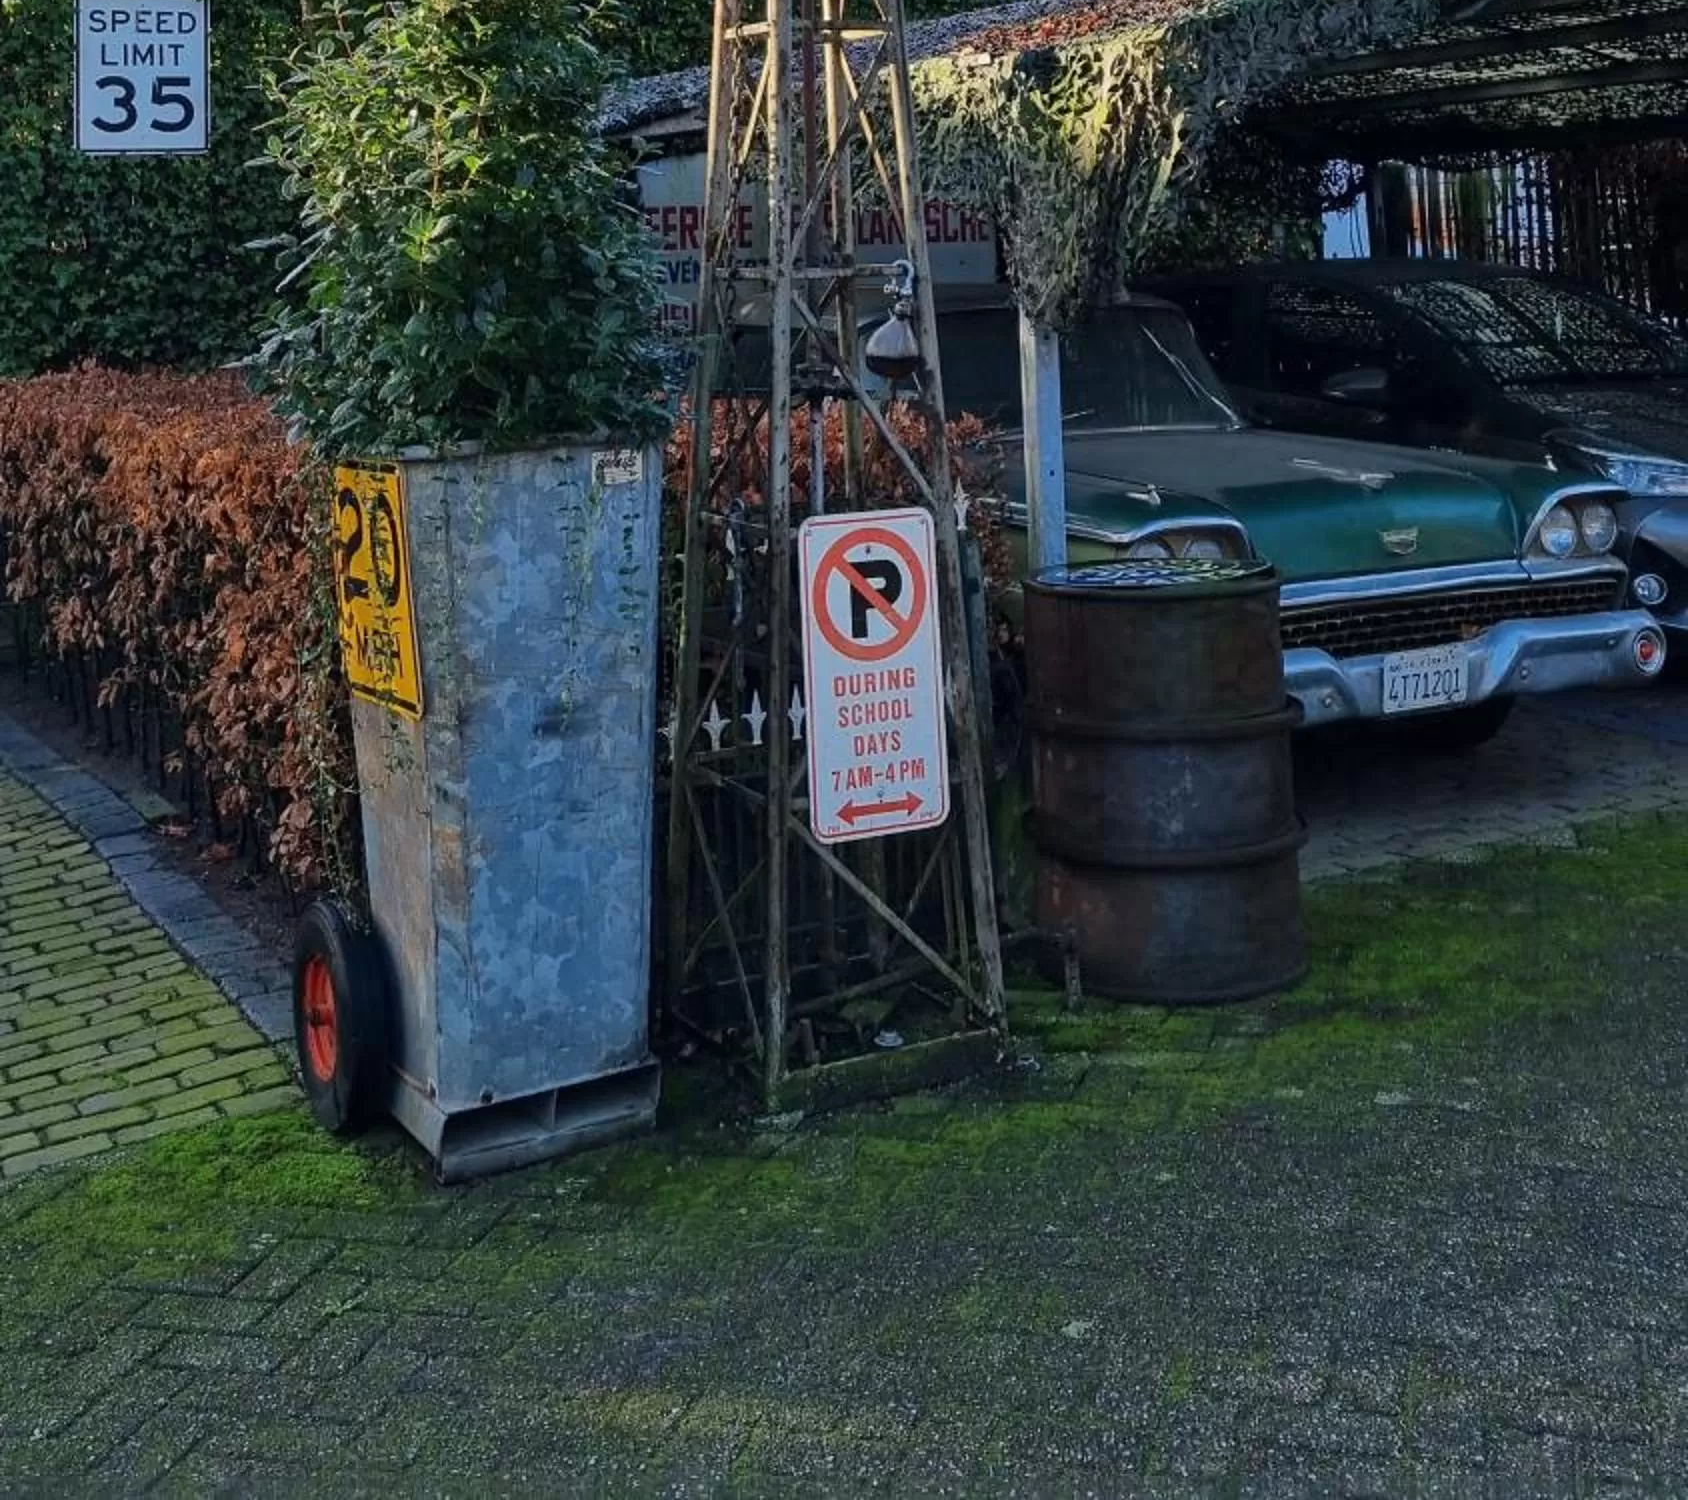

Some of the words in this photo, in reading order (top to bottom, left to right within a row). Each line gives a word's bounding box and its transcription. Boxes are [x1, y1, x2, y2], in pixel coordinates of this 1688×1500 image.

[89, 9, 197, 34] SPEED
[101, 43, 184, 67] LIMIT
[91, 76, 195, 133] 35
[338, 487, 400, 607] 20
[834, 667, 915, 697] DURING
[838, 699, 913, 729] SCHOOL
[854, 730, 901, 757] DAYS
